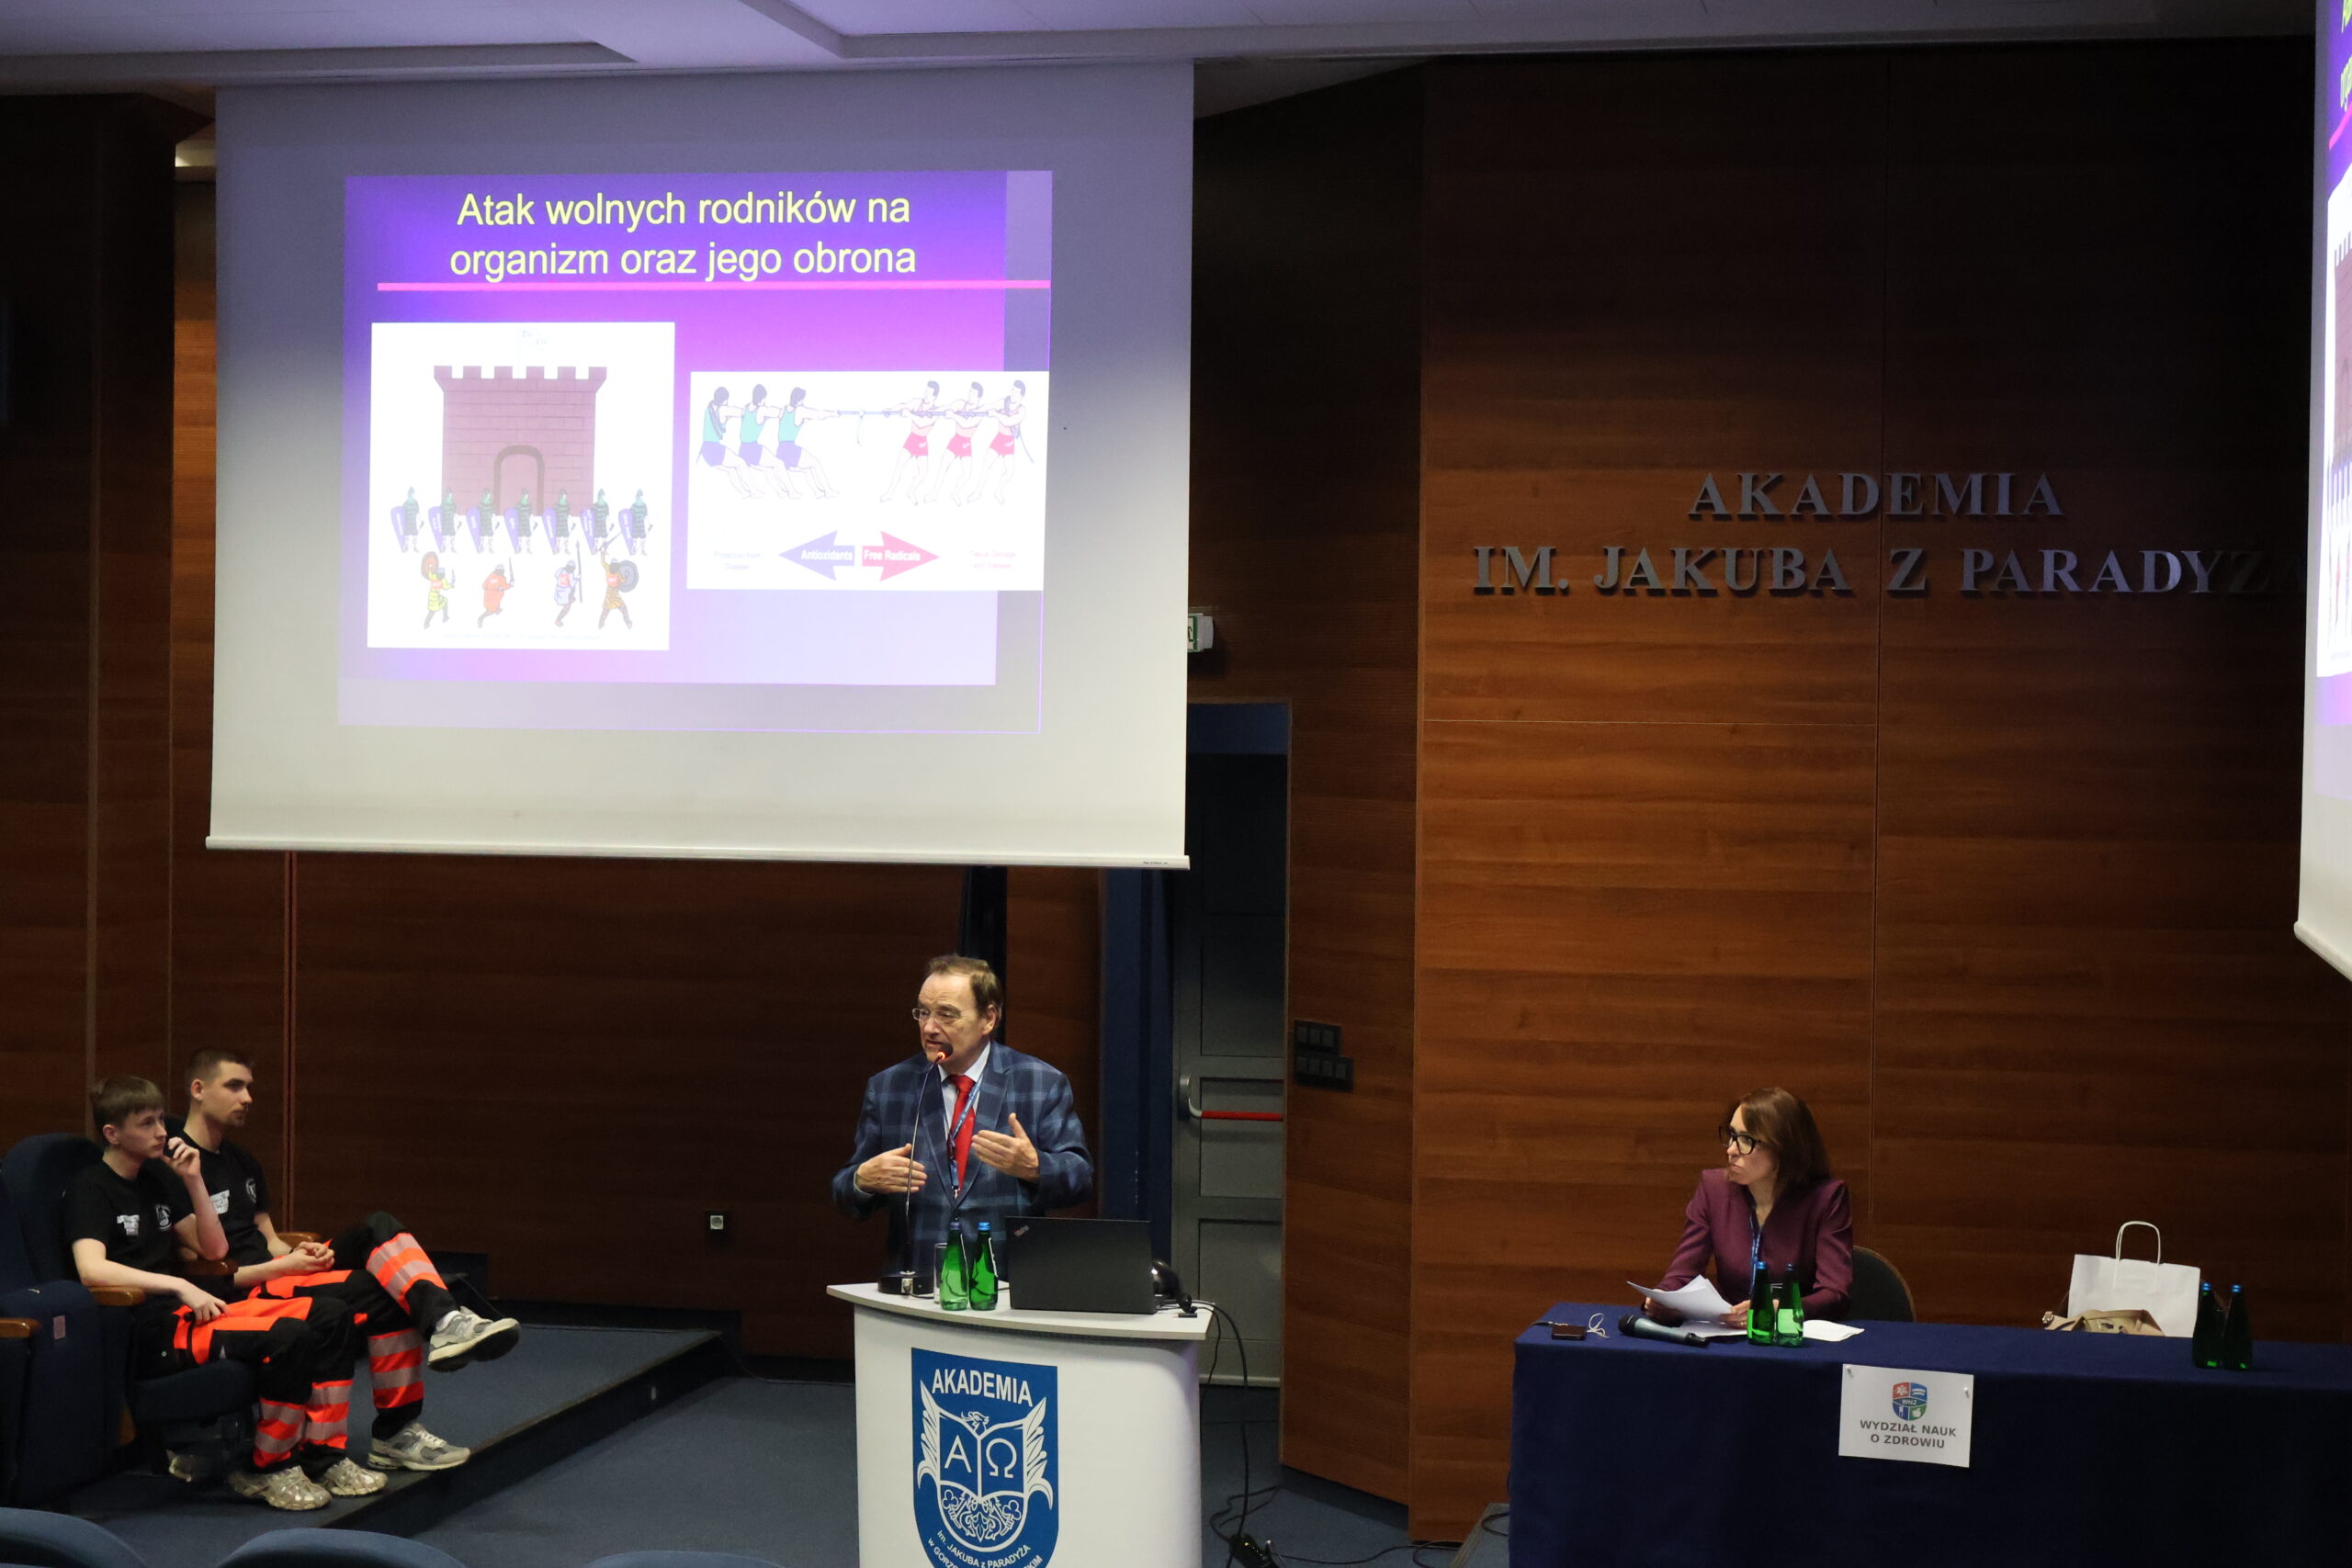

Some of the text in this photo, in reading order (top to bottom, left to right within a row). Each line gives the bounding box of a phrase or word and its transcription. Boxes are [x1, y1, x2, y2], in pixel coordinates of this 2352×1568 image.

[457, 191, 910, 232] Atak wolnych rodników na
[450, 241, 916, 283] organizm oraz jego obrona
[1689, 472, 2065, 517] AKADEMIA
[801, 549, 853, 561] Antioxidants
[865, 550, 921, 562] Free Radicals
[1474, 547, 1568, 592] IM.
[1593, 547, 1852, 592] JAKUBA
[1887, 548, 1927, 592] Z
[932, 1369, 1033, 1407] AKADEMIA
[1860, 1419, 1956, 1437] WYDZIAŁ NAUK
[1871, 1434, 1945, 1449] O ZDROWIU
[947, 1544, 979, 1568] JAKUBA
